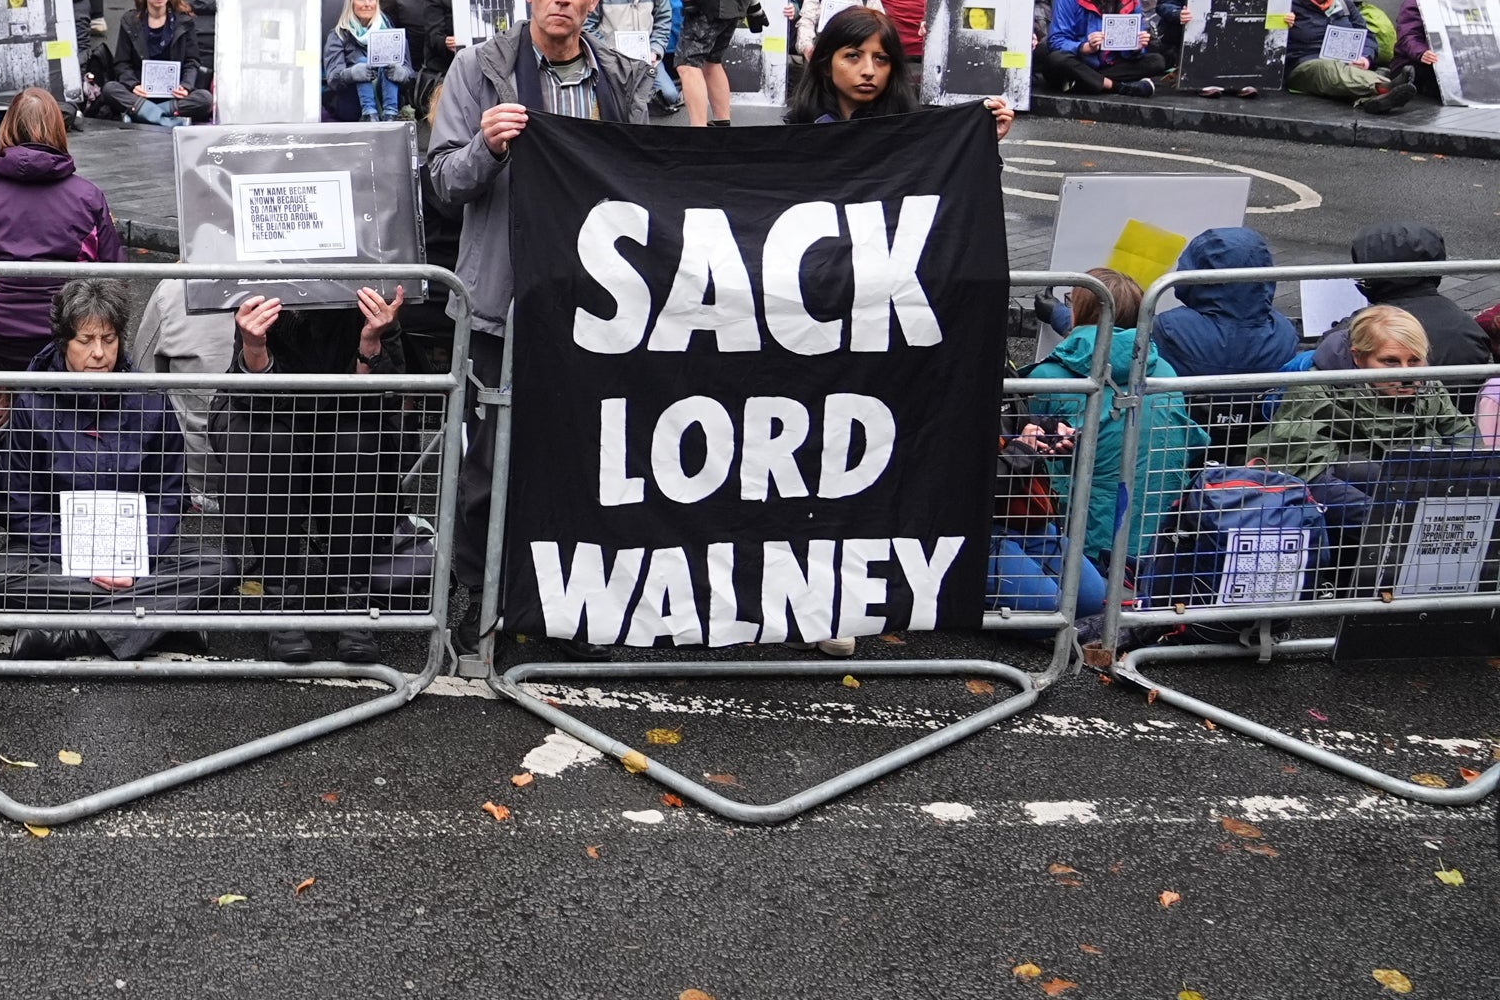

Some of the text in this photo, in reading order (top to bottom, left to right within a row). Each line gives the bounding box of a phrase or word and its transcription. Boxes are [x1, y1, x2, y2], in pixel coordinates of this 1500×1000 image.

[267, 187, 287, 196] NAME
[290, 186, 317, 195] BECAME
[250, 197, 275, 205] KNOWN
[277, 196, 307, 205] BECAUSE
[250, 204, 309, 214] SO MANY PEOPLE
[251, 212, 318, 223] ORGANIZED AROUND
[252, 220, 324, 231] THE DEMAND FOR MY
[573, 195, 942, 355] SACK
[600, 393, 896, 506] LORD
[530, 536, 965, 648] WALNEY
